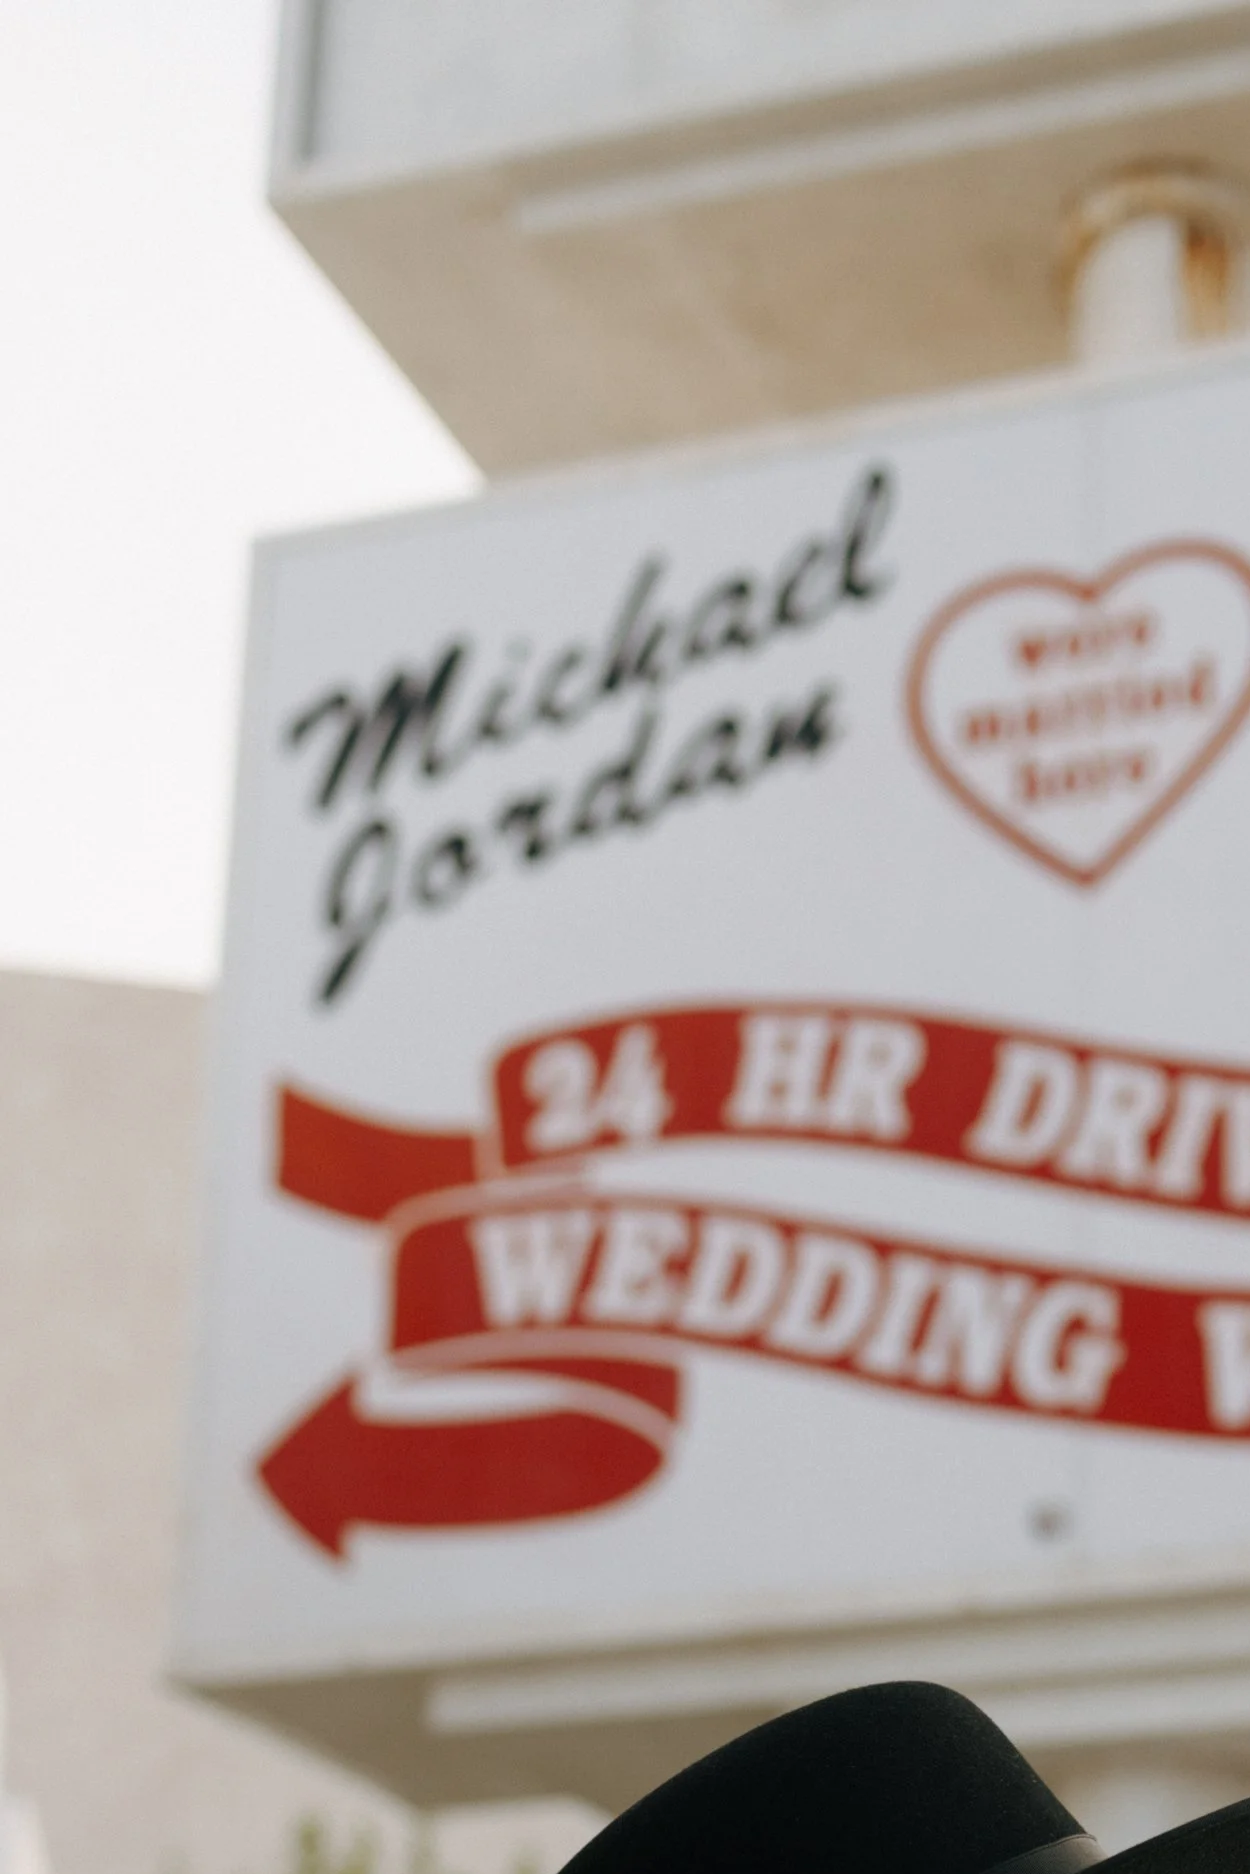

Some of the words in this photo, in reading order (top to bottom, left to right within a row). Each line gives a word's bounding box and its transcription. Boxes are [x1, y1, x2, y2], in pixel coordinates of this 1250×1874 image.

[287, 459, 892, 812] Michael
[317, 680, 840, 1010] Jordan
[522, 1022, 673, 1152] 24
[723, 1012, 928, 1141] HR
[470, 1204, 1126, 1413] WEDDING
